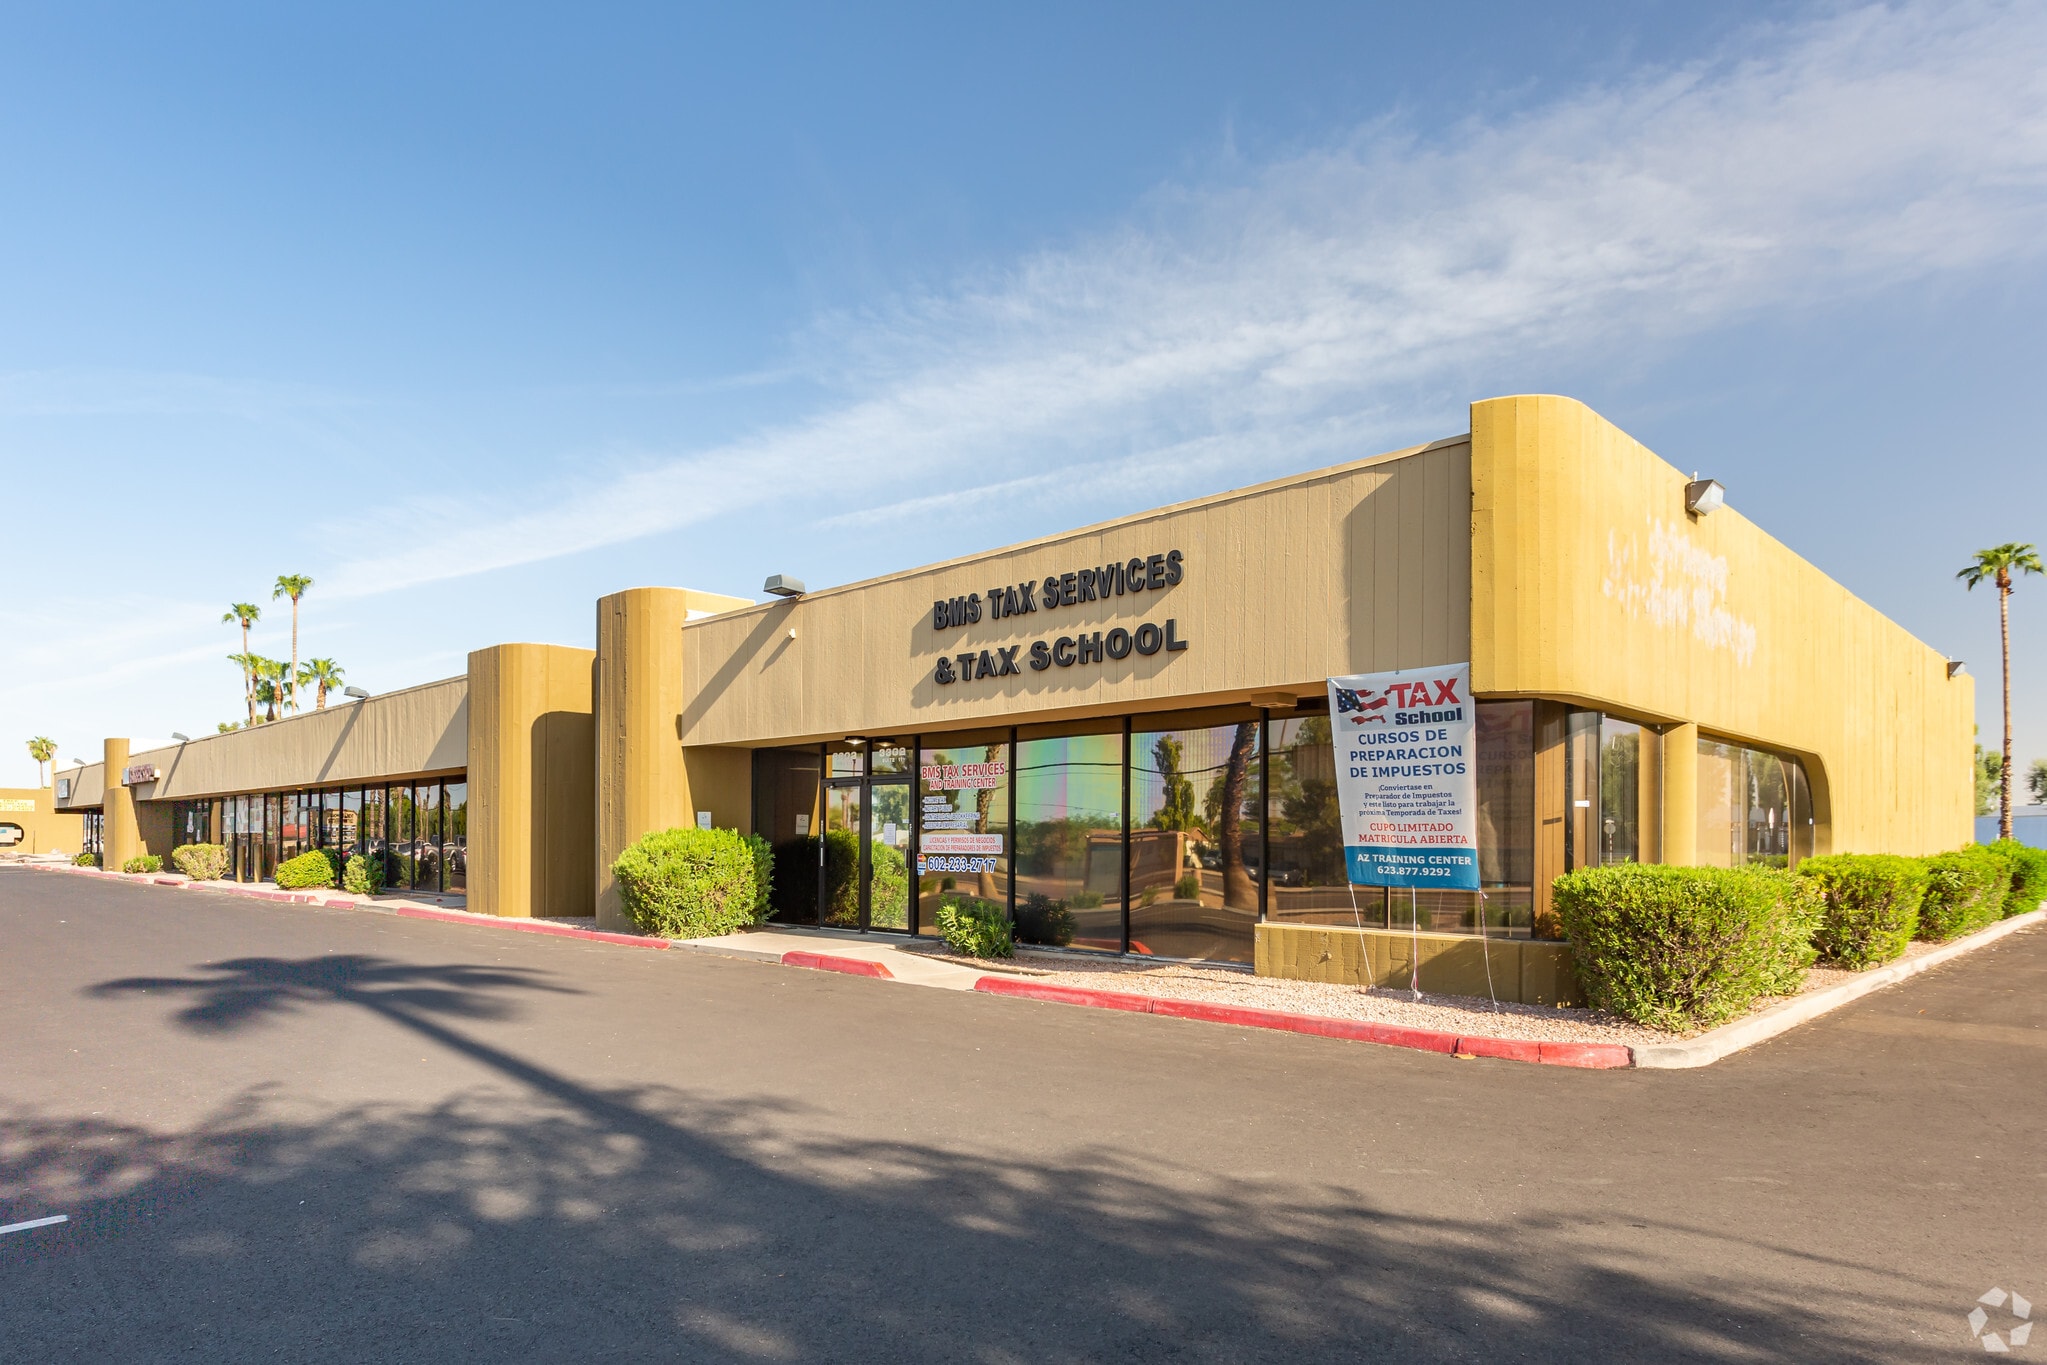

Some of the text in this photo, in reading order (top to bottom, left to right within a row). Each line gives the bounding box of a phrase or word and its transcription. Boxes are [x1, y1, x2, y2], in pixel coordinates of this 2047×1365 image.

[933, 549, 1184, 630] BMS TAX SERVICES
[1029, 618, 1189, 671] SCHOOL
[1389, 678, 1460, 709] TAX
[1395, 707, 1462, 725] School
[1358, 729, 1447, 745] CURSOS DE
[1350, 745, 1462, 761] PREPARACION
[922, 762, 1005, 779] BMS TAX SERVICES
[1350, 767, 1368, 778] DE
[1372, 762, 1466, 778] IMPUESTOS
[930, 777, 996, 789] AND TRAINING CENTER
[1364, 792, 1400, 800] Preparador
[1412, 791, 1452, 799] Impuestos
[1415, 800, 1446, 809] trabajar
[1386, 809, 1426, 817] Temporada
[1369, 822, 1454, 832] CUPO LIMITADO
[1358, 834, 1468, 844] MATRICULA ABIERTA
[928, 857, 996, 873] 602-233-2717
[1357, 853, 1472, 865] AZ TRAINING CENTER
[1377, 866, 1451, 876] 623.877.9292
